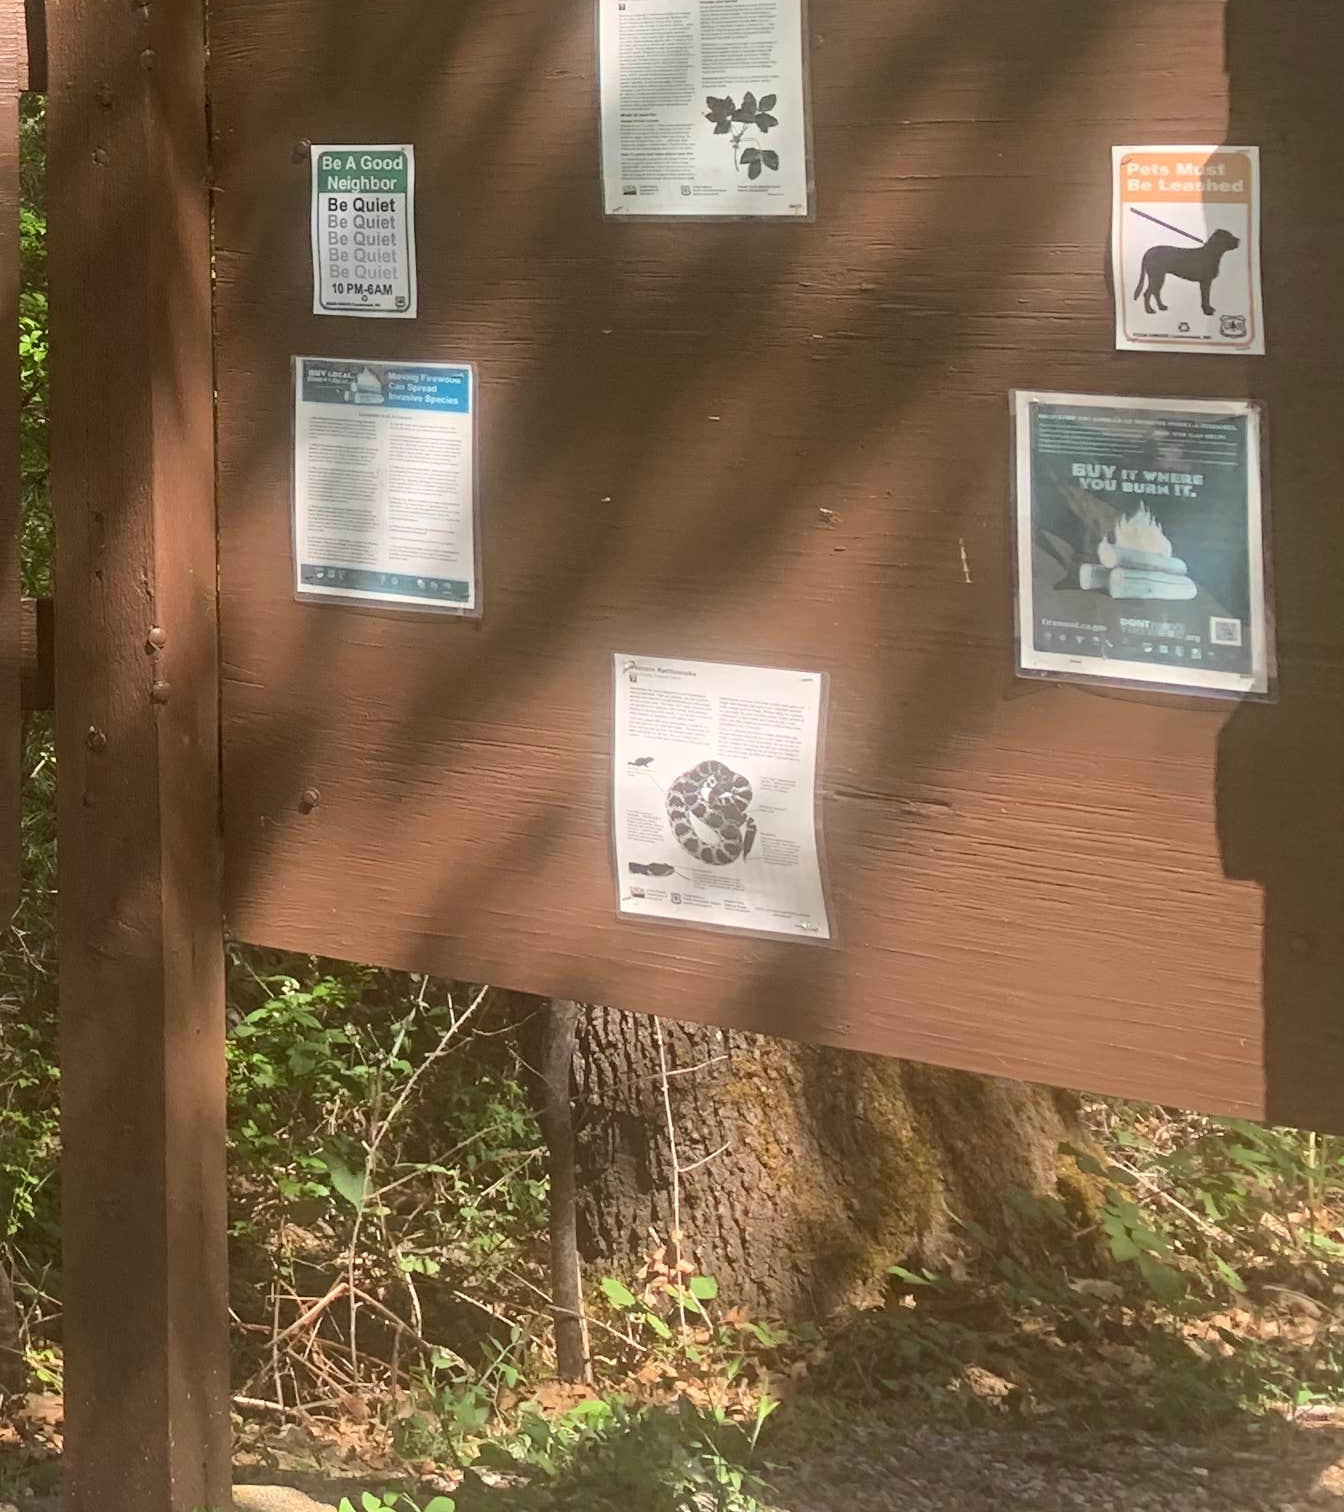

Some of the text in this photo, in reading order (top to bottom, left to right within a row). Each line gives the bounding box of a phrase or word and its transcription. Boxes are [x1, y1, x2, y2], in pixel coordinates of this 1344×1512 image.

[322, 156, 403, 171] Be A Good
[1127, 163, 1225, 176] Pets Must
[327, 176, 397, 193] Neighbor
[1127, 179, 1244, 192] Be Leashed
[328, 197, 396, 212] Be Quiet
[328, 215, 396, 230] Be Quiet
[328, 231, 397, 246] Be Quiet
[329, 248, 398, 263] Be Quiet
[330, 264, 399, 280] Be Quiet
[332, 283, 344, 294] 10
[388, 382, 437, 393] Can Spread
[388, 393, 459, 405] Invasive Species
[1072, 463, 1204, 486] BUY IT WHERE
[1079, 477, 1117, 491] YOU
[1121, 483, 1170, 496] BURN
